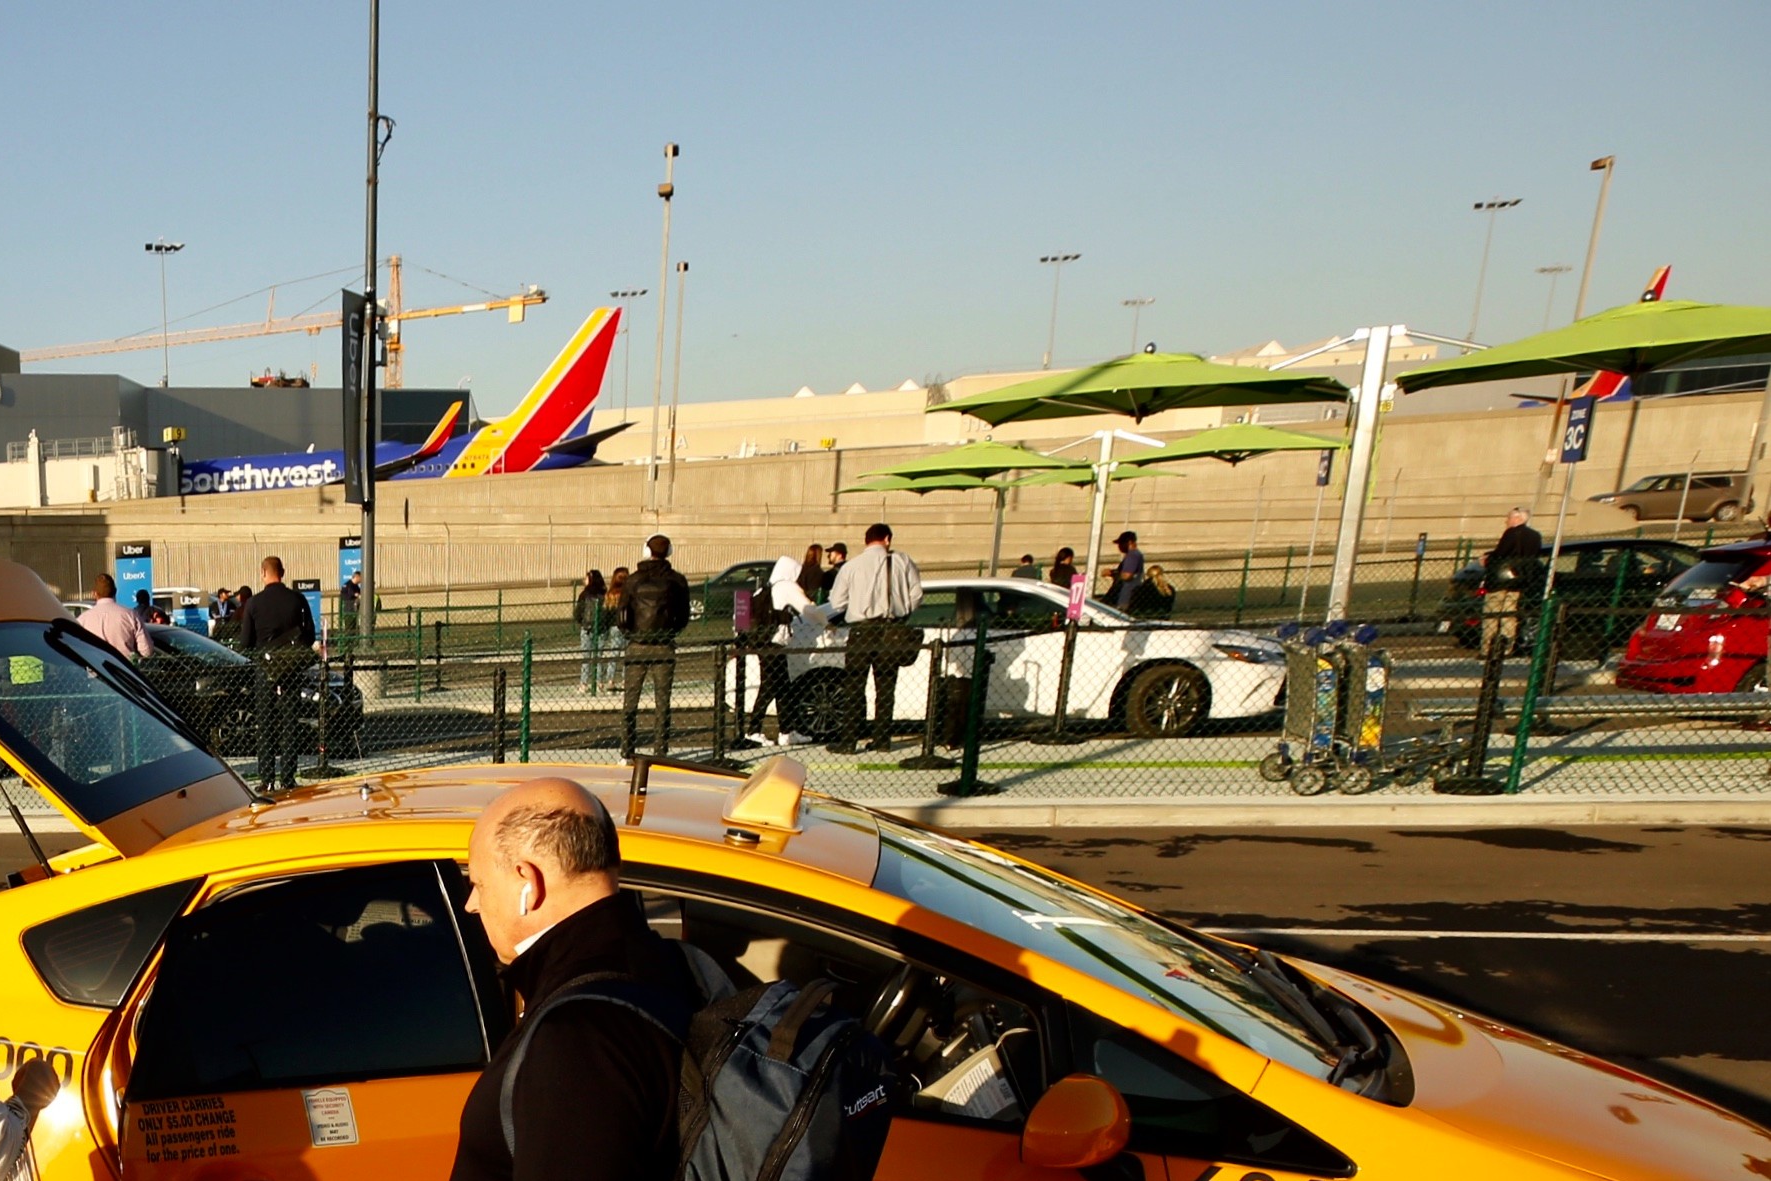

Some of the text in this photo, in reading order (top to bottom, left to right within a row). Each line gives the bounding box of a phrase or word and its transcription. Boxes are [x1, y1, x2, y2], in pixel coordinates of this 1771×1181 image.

[1564, 423, 1585, 451] 3C
[180, 459, 338, 494] Southwest
[122, 545, 144, 555] Uber
[122, 571, 146, 580] UberX
[297, 582, 315, 590] Uber
[179, 596, 202, 605] Uber
[1071, 581, 1085, 605] 17
[141, 1097, 225, 1116] DRIVER CARRIES
[137, 1109, 237, 1132] ONLY $5.00 CHANGE
[145, 1125, 236, 1147] All passengers ride
[146, 1142, 240, 1163] for the price of one.
